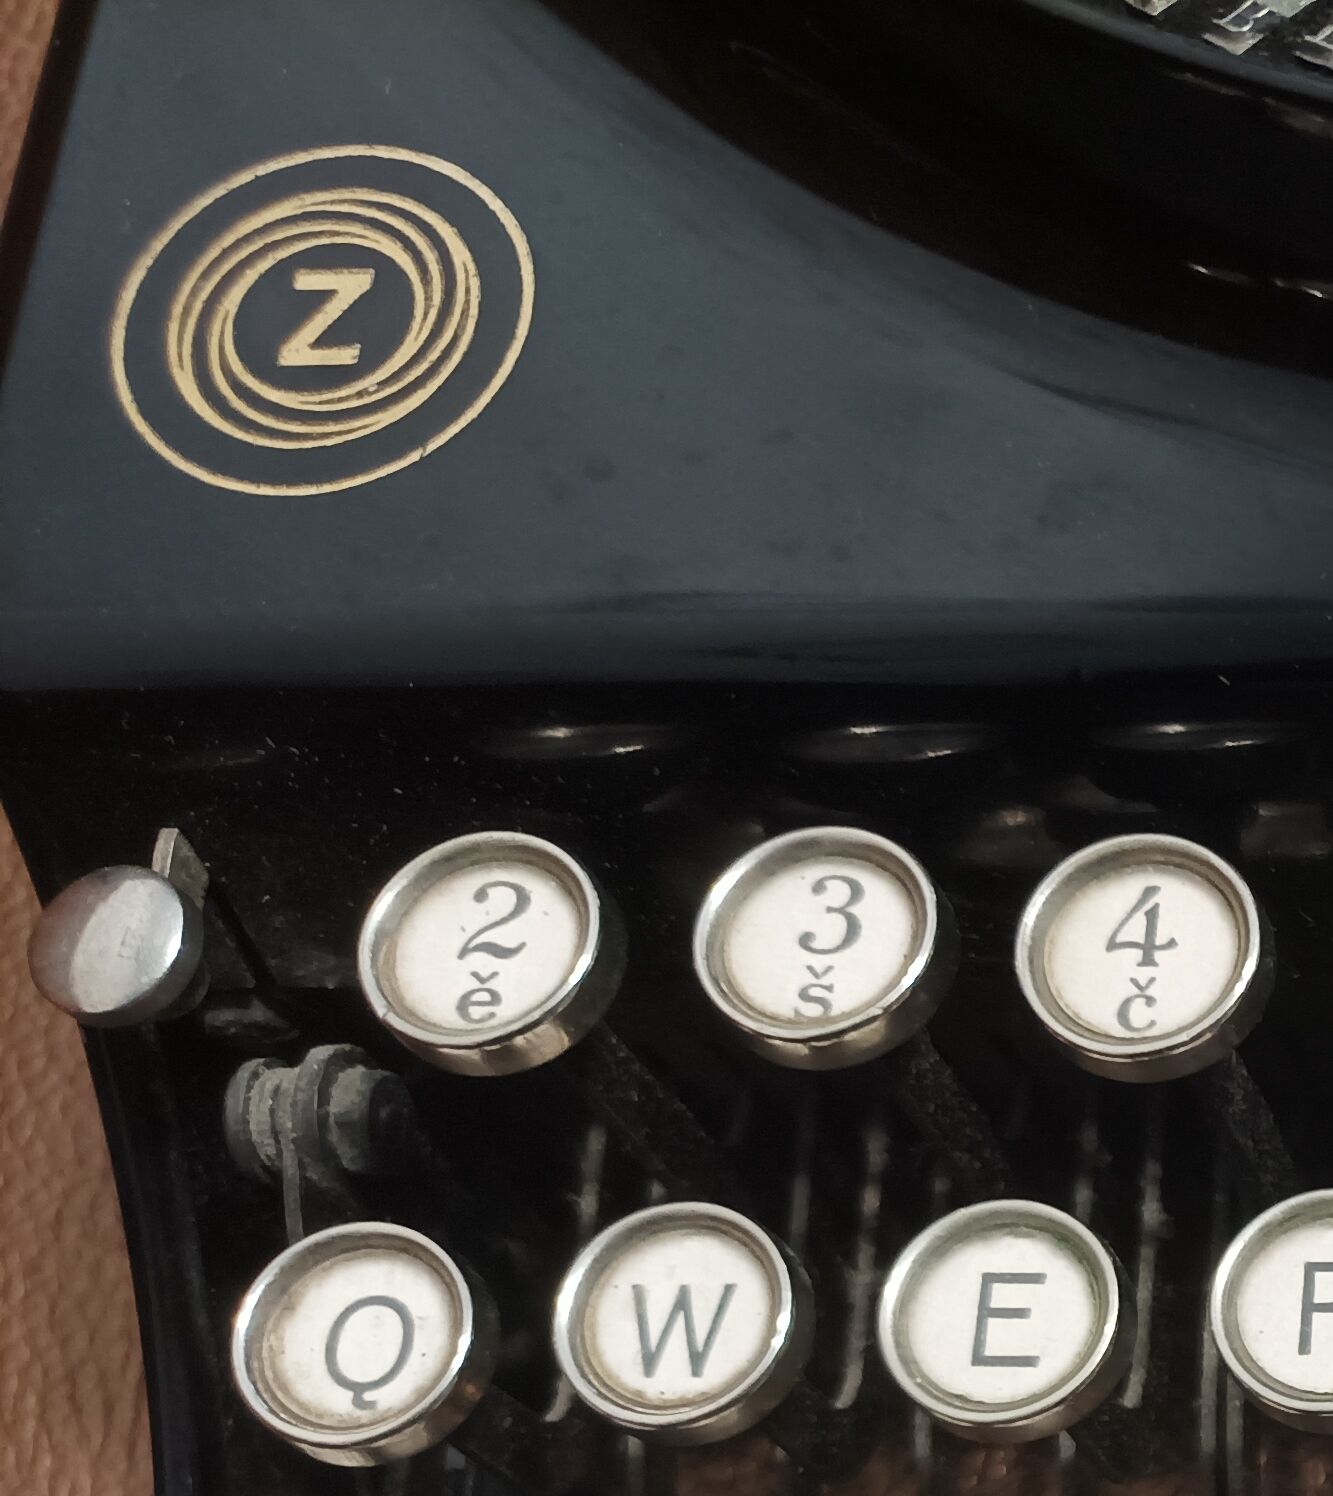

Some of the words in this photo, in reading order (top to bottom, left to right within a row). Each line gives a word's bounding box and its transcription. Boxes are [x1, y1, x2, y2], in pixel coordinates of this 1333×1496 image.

[277, 268, 375, 366] Z
[458, 880, 532, 960] 2
[798, 875, 866, 955] 3
[1106, 886, 1178, 967] 4
[455, 971, 502, 1023] ě
[794, 964, 834, 1019] š
[1117, 977, 1156, 1032] č
[325, 1295, 415, 1410] Q
[631, 1284, 738, 1379] W
[970, 1272, 1047, 1368] E
